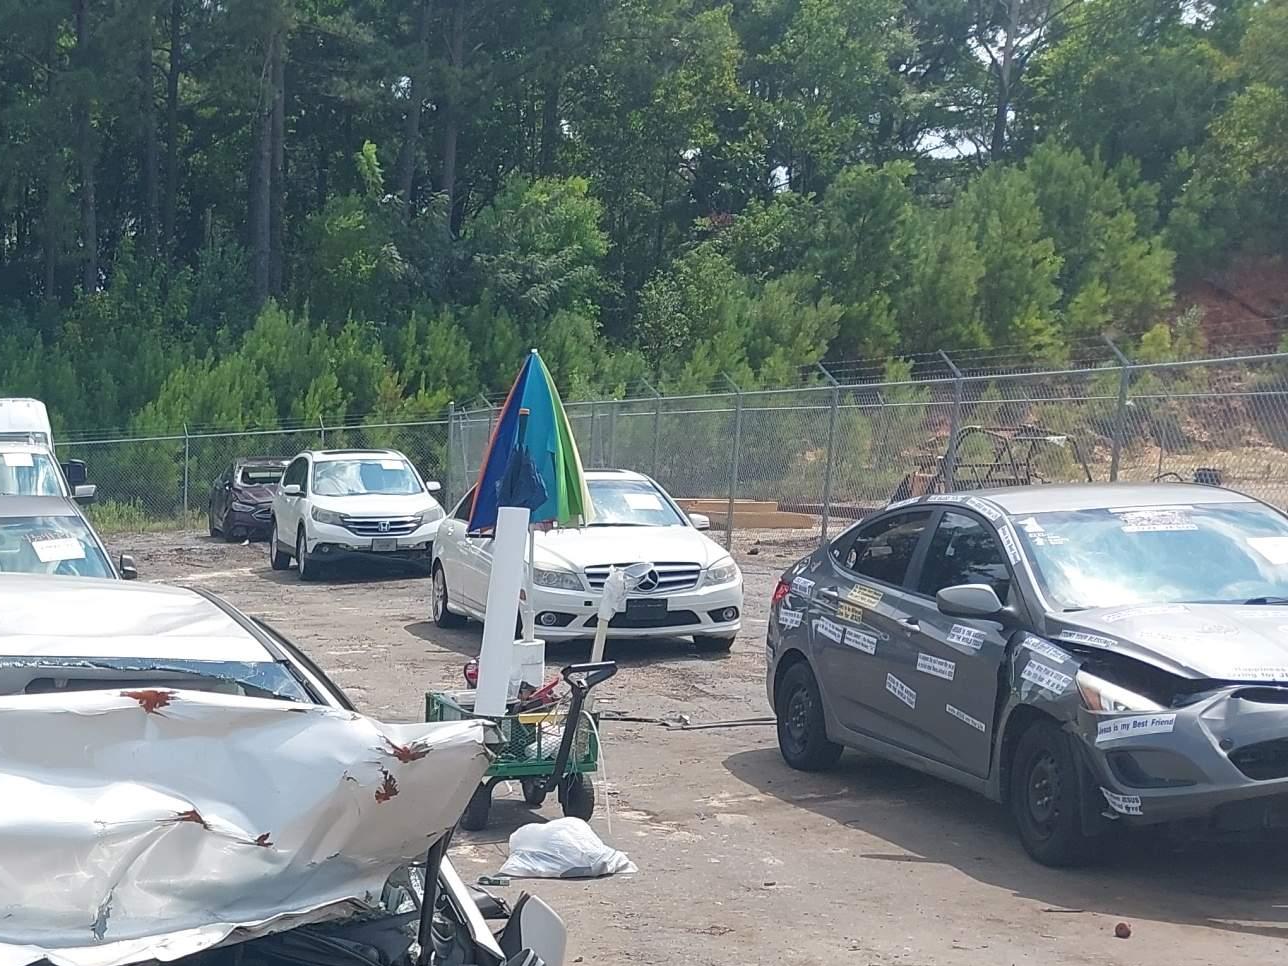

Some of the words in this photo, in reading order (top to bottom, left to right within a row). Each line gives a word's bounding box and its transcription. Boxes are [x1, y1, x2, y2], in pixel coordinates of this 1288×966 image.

[1113, 723, 1119, 731] is
[1121, 723, 1130, 731] my
[1132, 719, 1148, 729] Best
[1151, 718, 1175, 727] Friend
